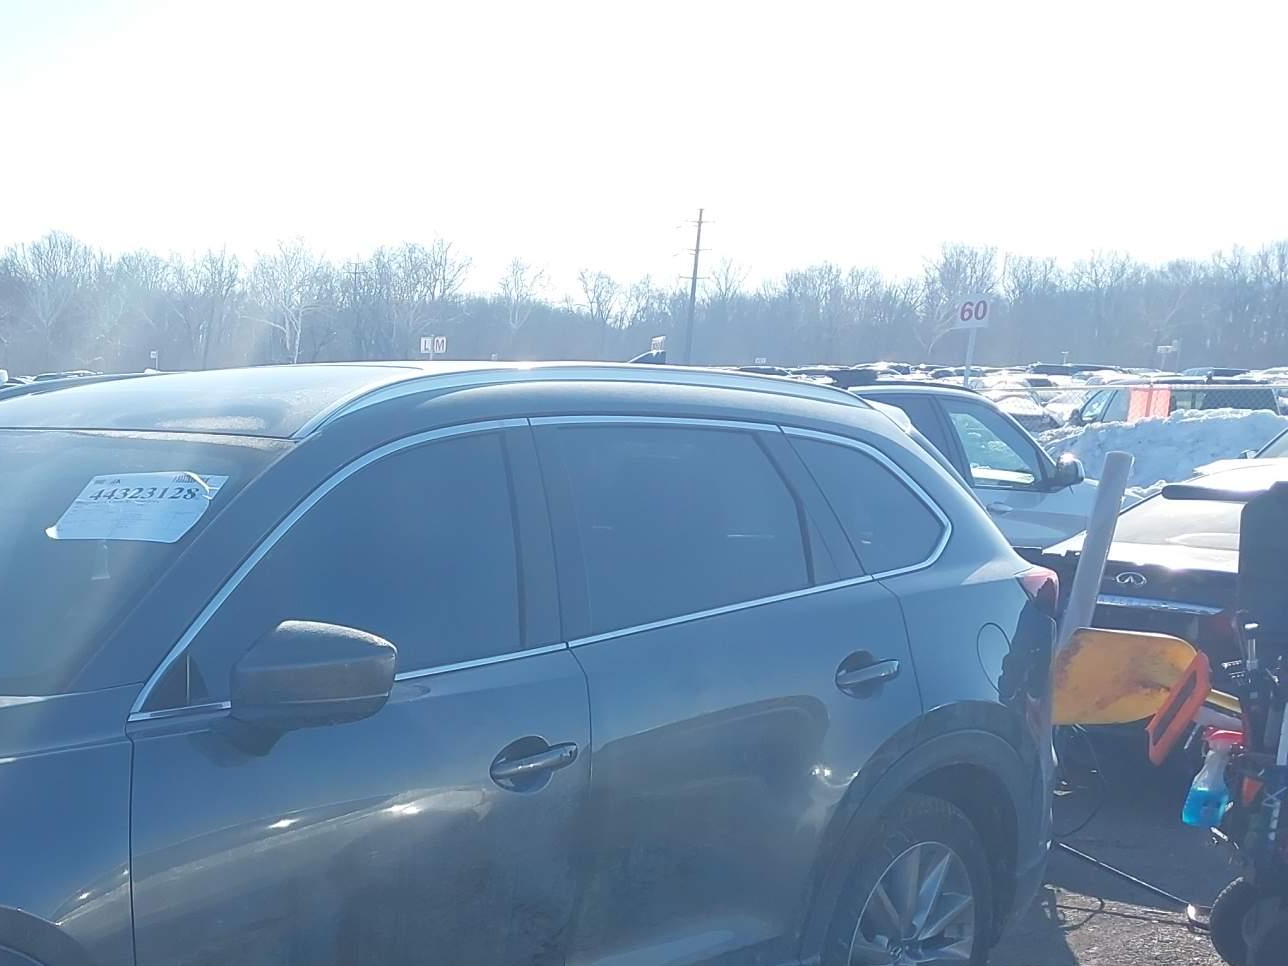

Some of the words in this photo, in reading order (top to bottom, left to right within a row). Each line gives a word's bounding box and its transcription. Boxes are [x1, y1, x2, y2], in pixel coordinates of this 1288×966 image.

[960, 300, 988, 321] 60
[435, 339, 444, 351] M
[88, 487, 200, 501] 44323128
